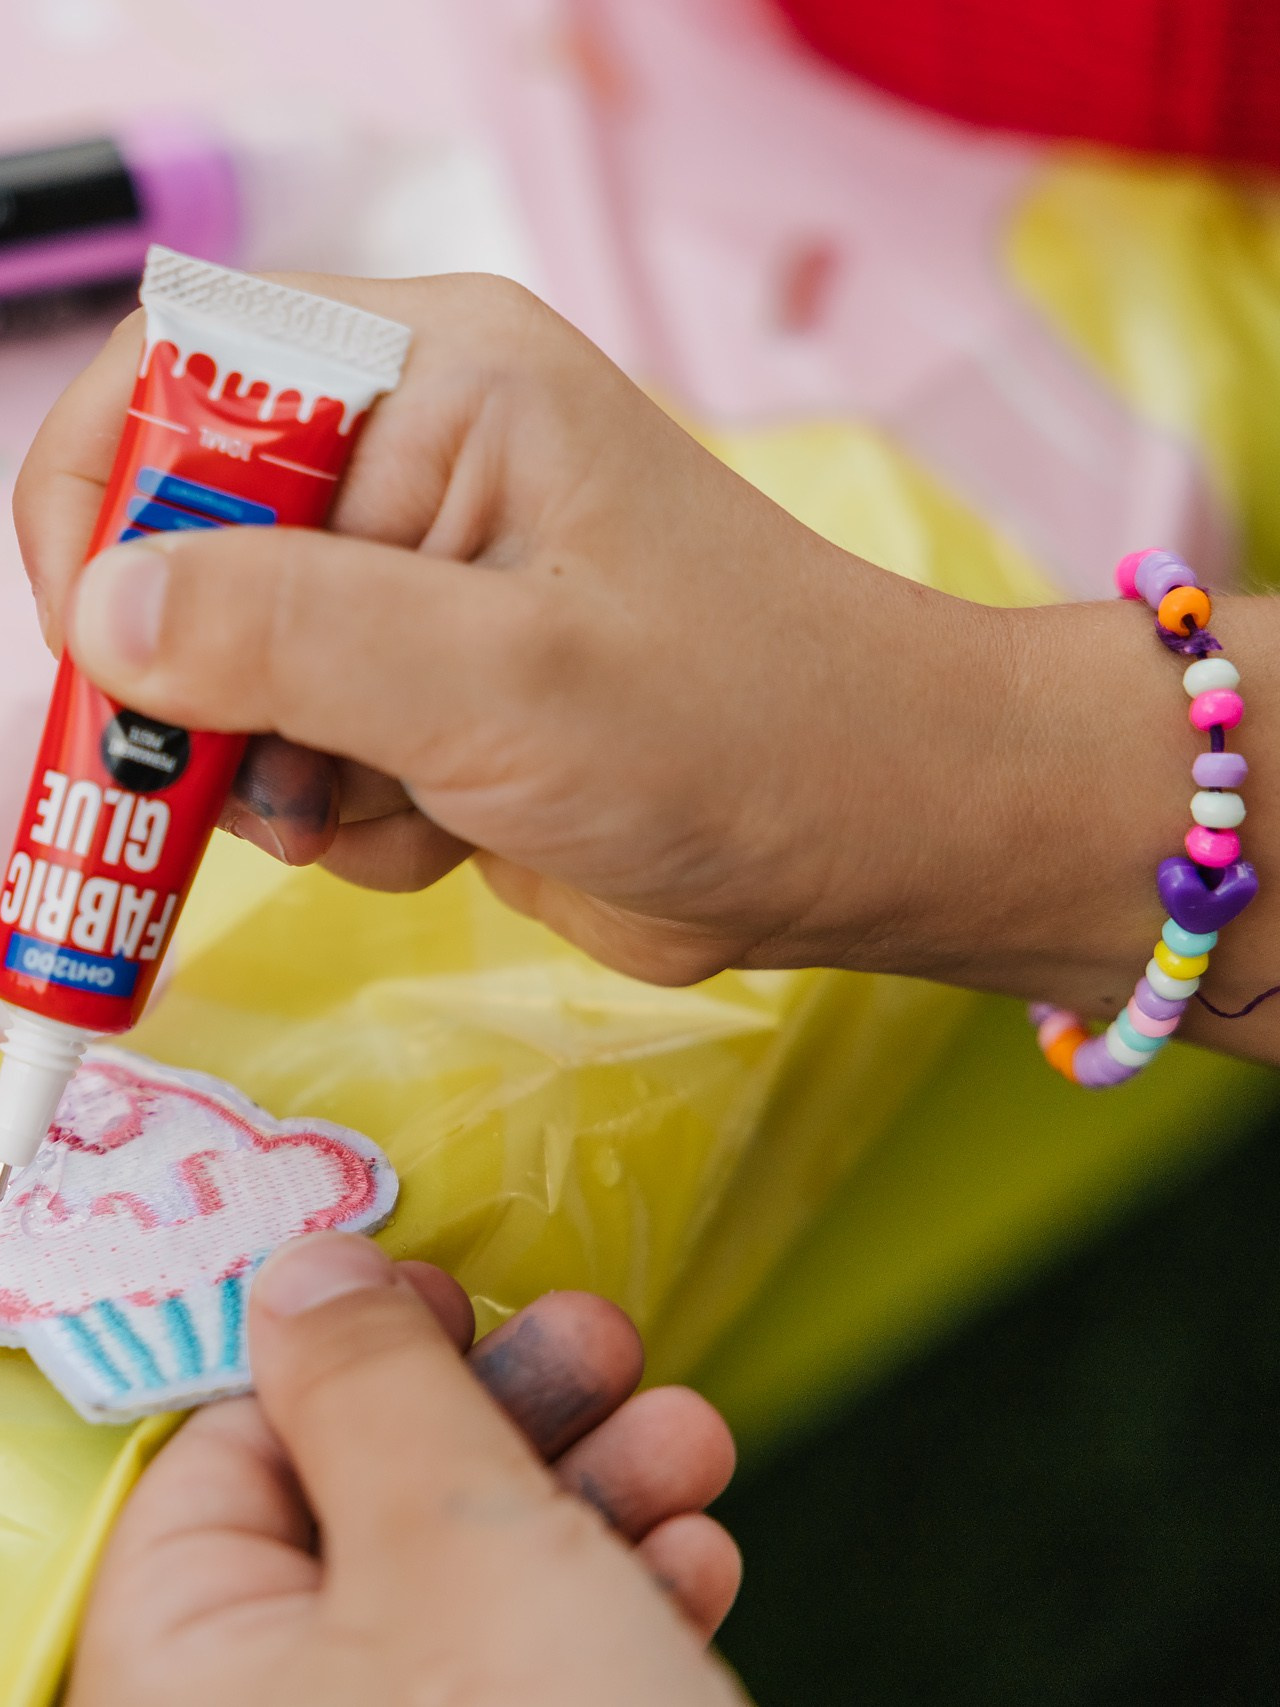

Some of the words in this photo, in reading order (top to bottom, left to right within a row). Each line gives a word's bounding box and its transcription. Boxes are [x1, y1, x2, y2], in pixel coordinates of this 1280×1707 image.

[30, 769, 171, 873] GLUE
[0, 851, 179, 961] FABRIC
[22, 946, 116, 988] GH1200
